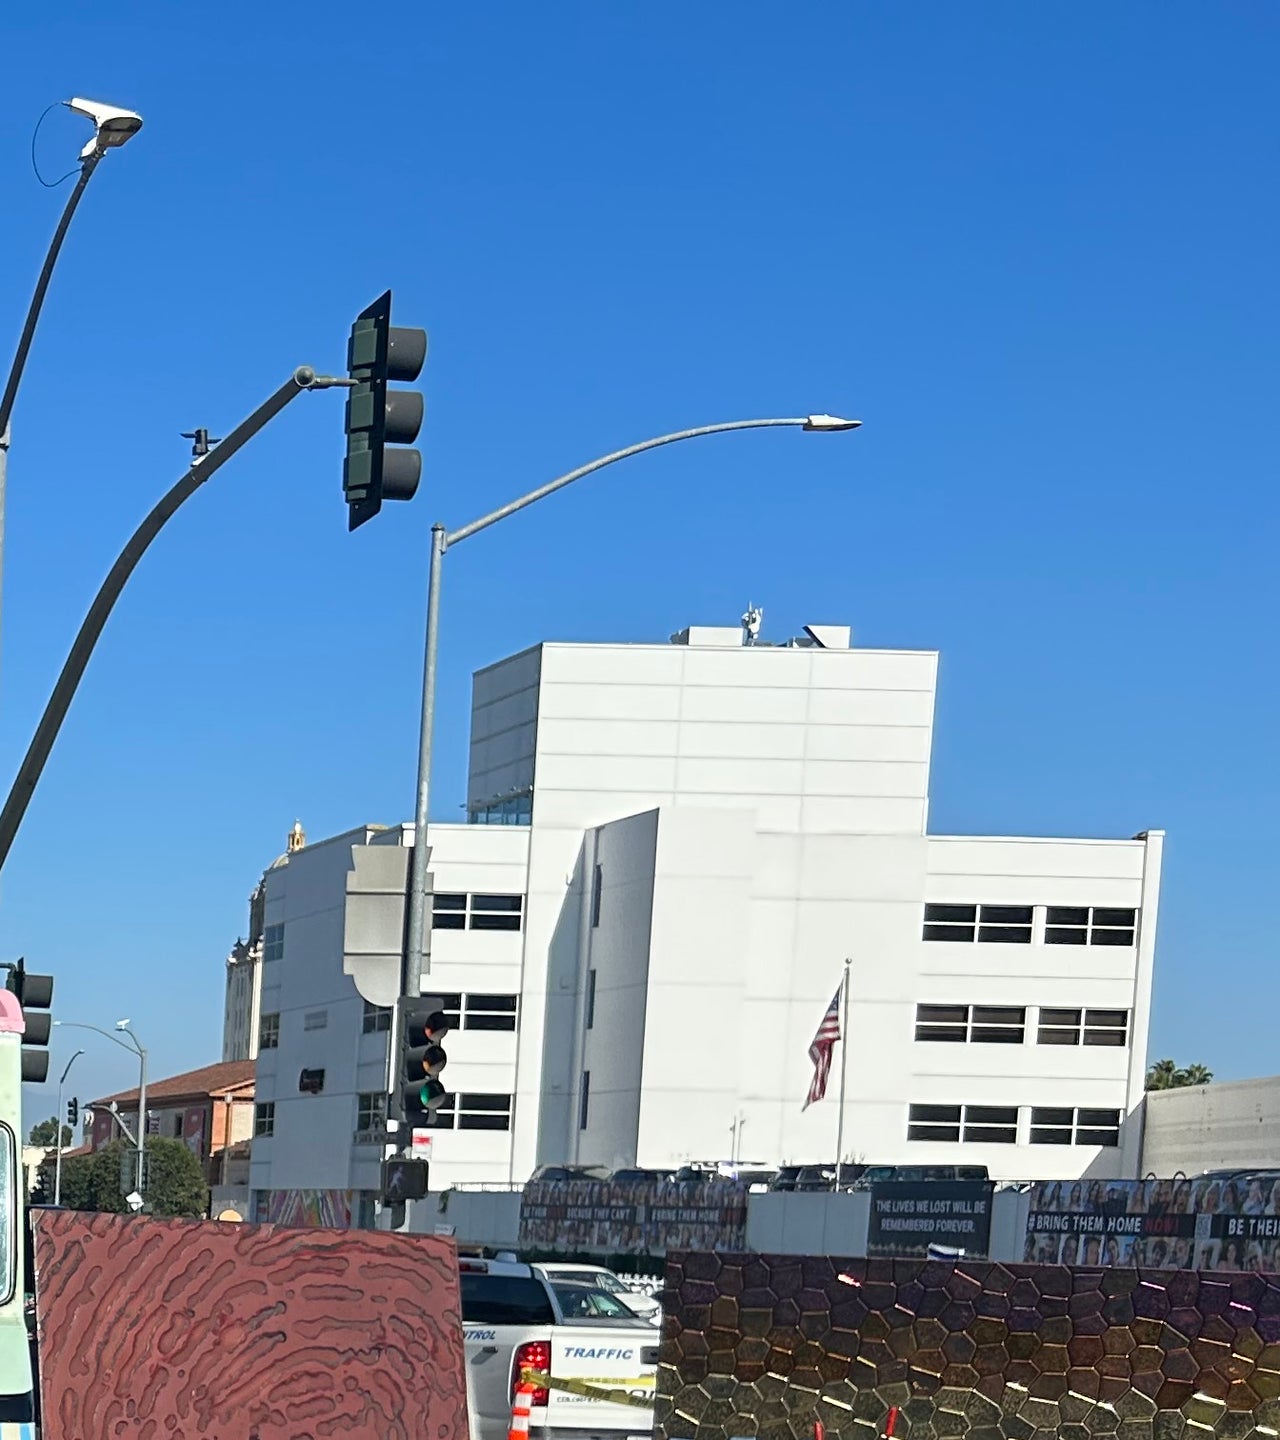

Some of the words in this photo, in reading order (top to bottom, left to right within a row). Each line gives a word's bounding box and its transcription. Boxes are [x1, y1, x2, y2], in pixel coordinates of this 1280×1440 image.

[876, 1200, 891, 1213] THE
[892, 1200, 915, 1213] LIVES
[916, 1200, 928, 1213] WE
[930, 1200, 951, 1213] LOST
[952, 1201, 972, 1214] WILL
[974, 1201, 986, 1214] BE
[881, 1218, 935, 1231] REMEMBERED
[936, 1219, 975, 1232] FOREVER.
[1072, 1214, 1104, 1232] THEM
[1107, 1215, 1141, 1233] HOME
[1228, 1218, 1244, 1235] BE
[564, 1347, 634, 1360] TRAFFIC
